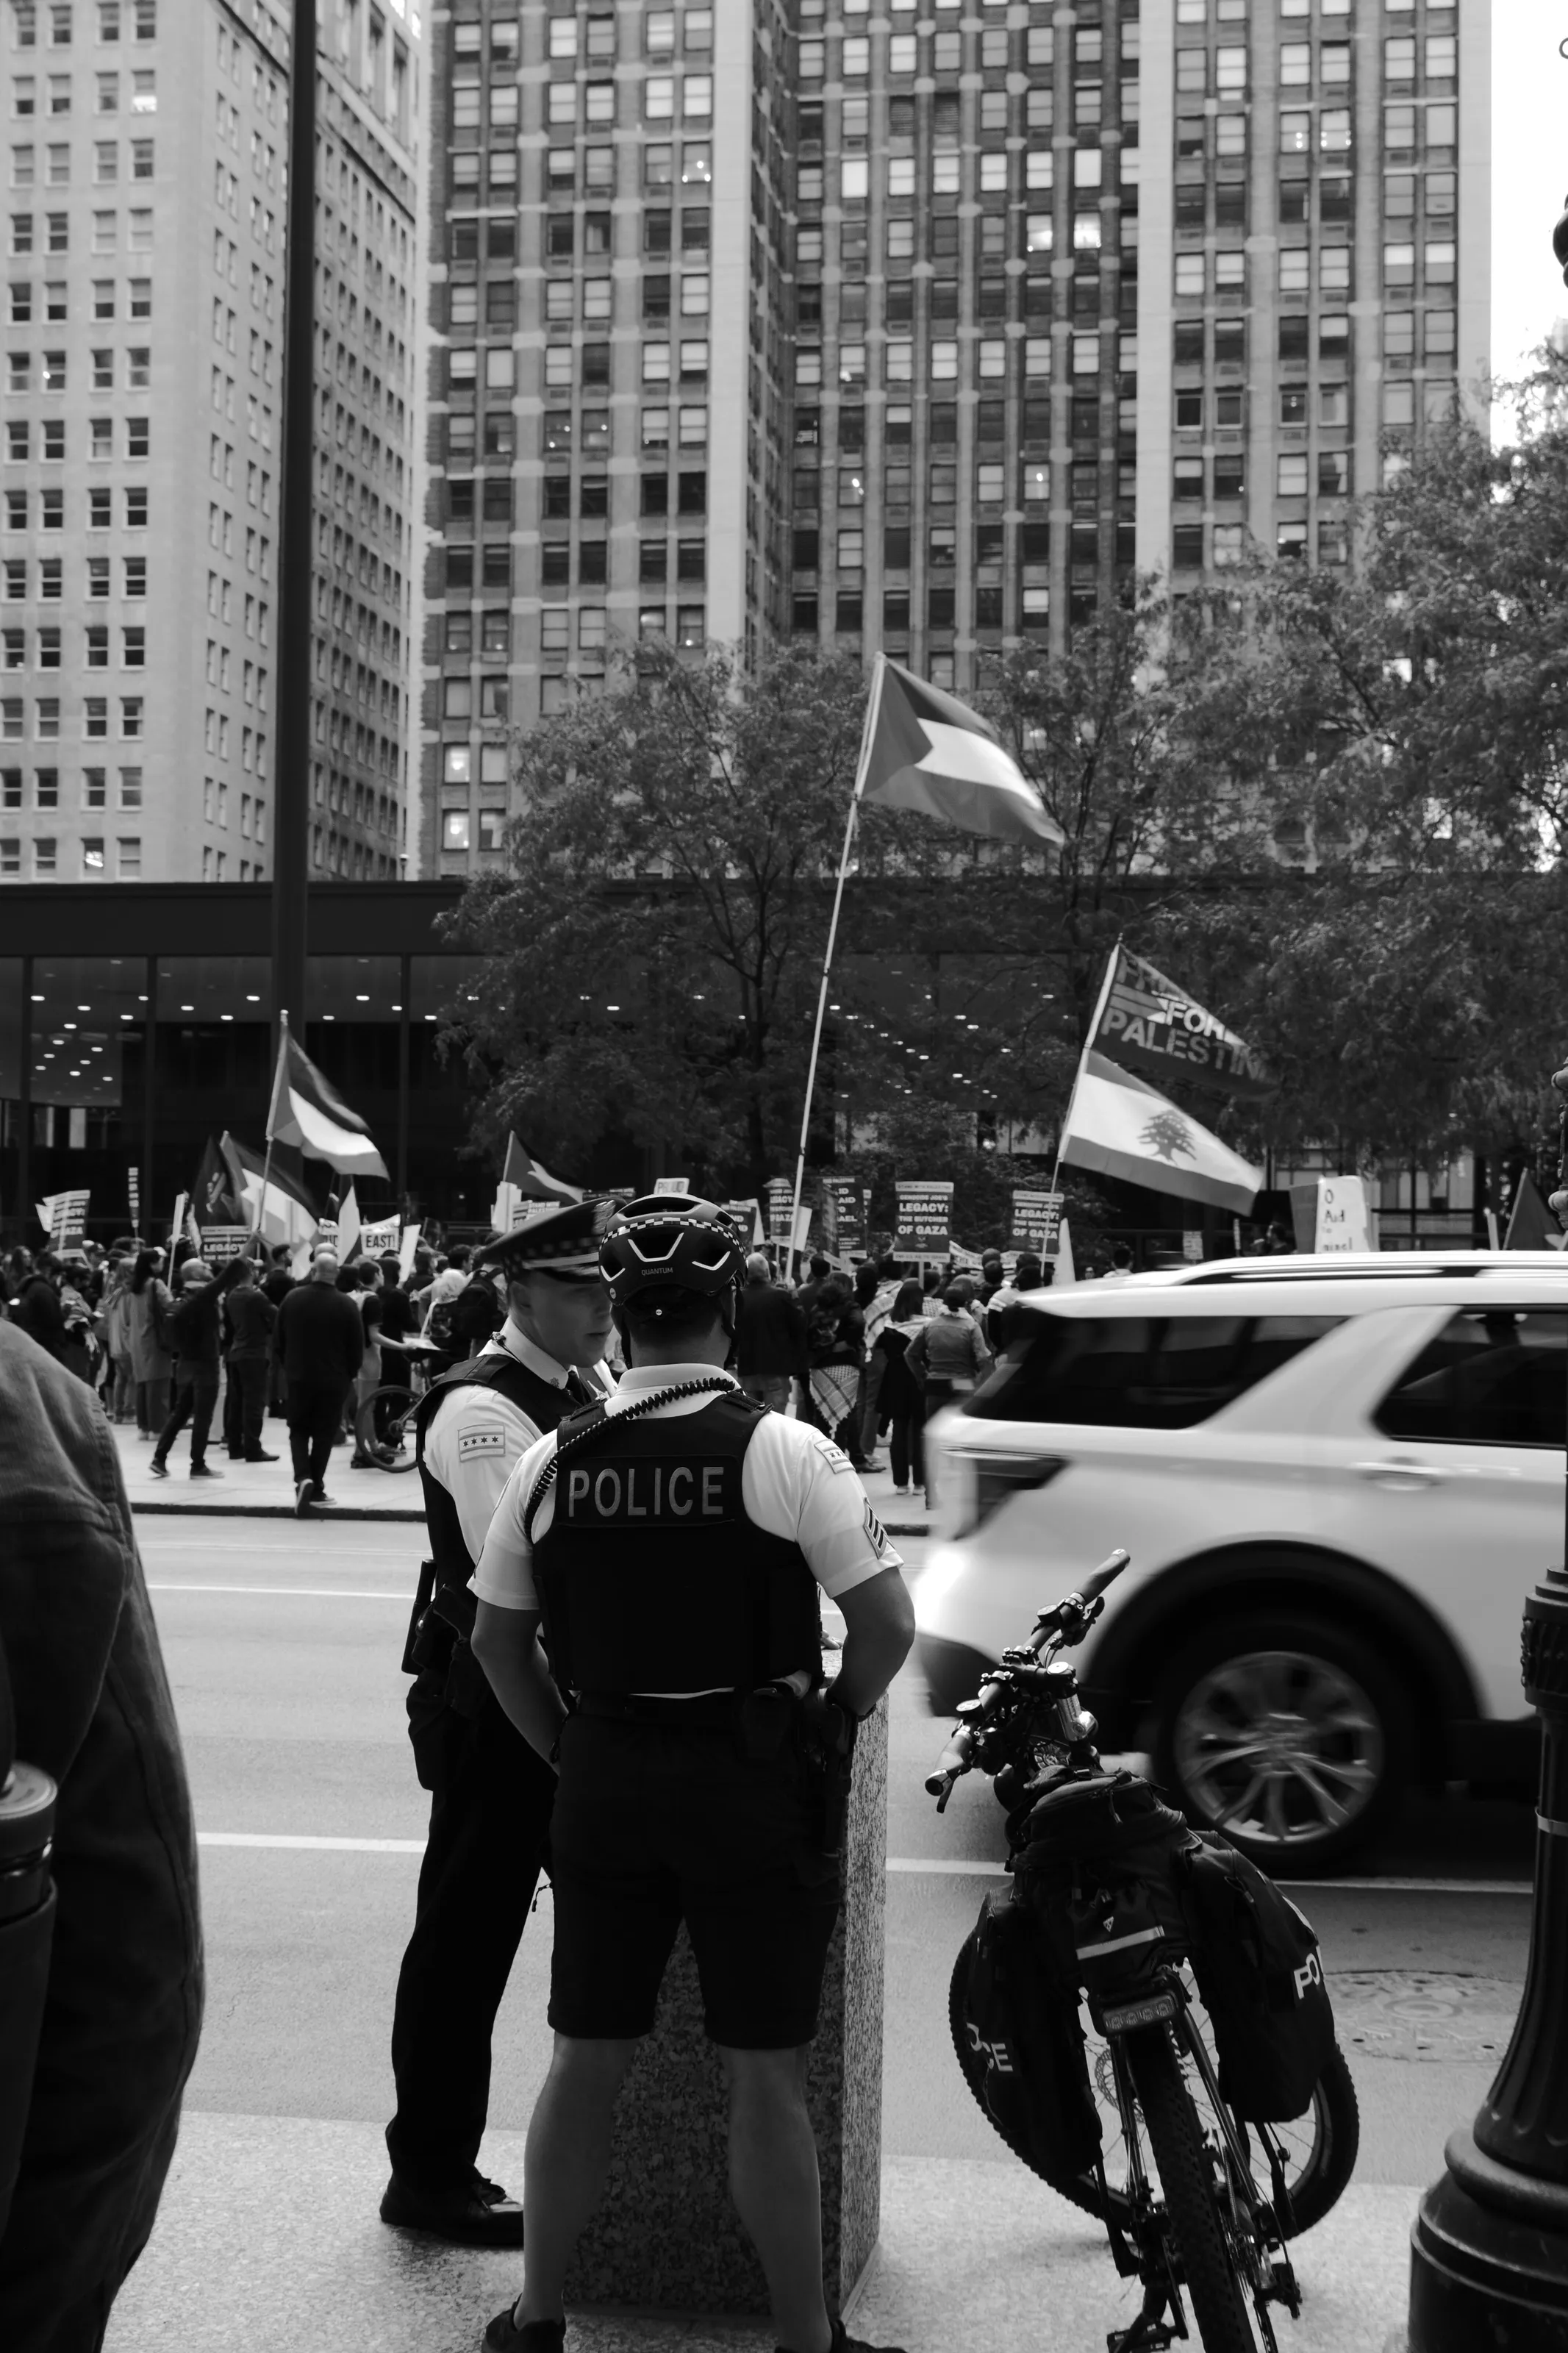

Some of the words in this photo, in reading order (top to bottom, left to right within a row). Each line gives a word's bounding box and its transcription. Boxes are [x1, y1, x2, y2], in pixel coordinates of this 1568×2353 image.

[1101, 1005, 1267, 1081] PALESTIN
[899, 1202, 949, 1213] LEGACY:
[1014, 1208, 1059, 1220] LEGACY:
[898, 1225, 914, 1235] OF
[915, 1225, 948, 1235] GAZA
[1012, 1227, 1028, 1237] OF
[1028, 1229, 1058, 1240] GAZA
[641, 1267, 673, 1276] QUANTUM
[568, 1466, 724, 1517] POLICE
